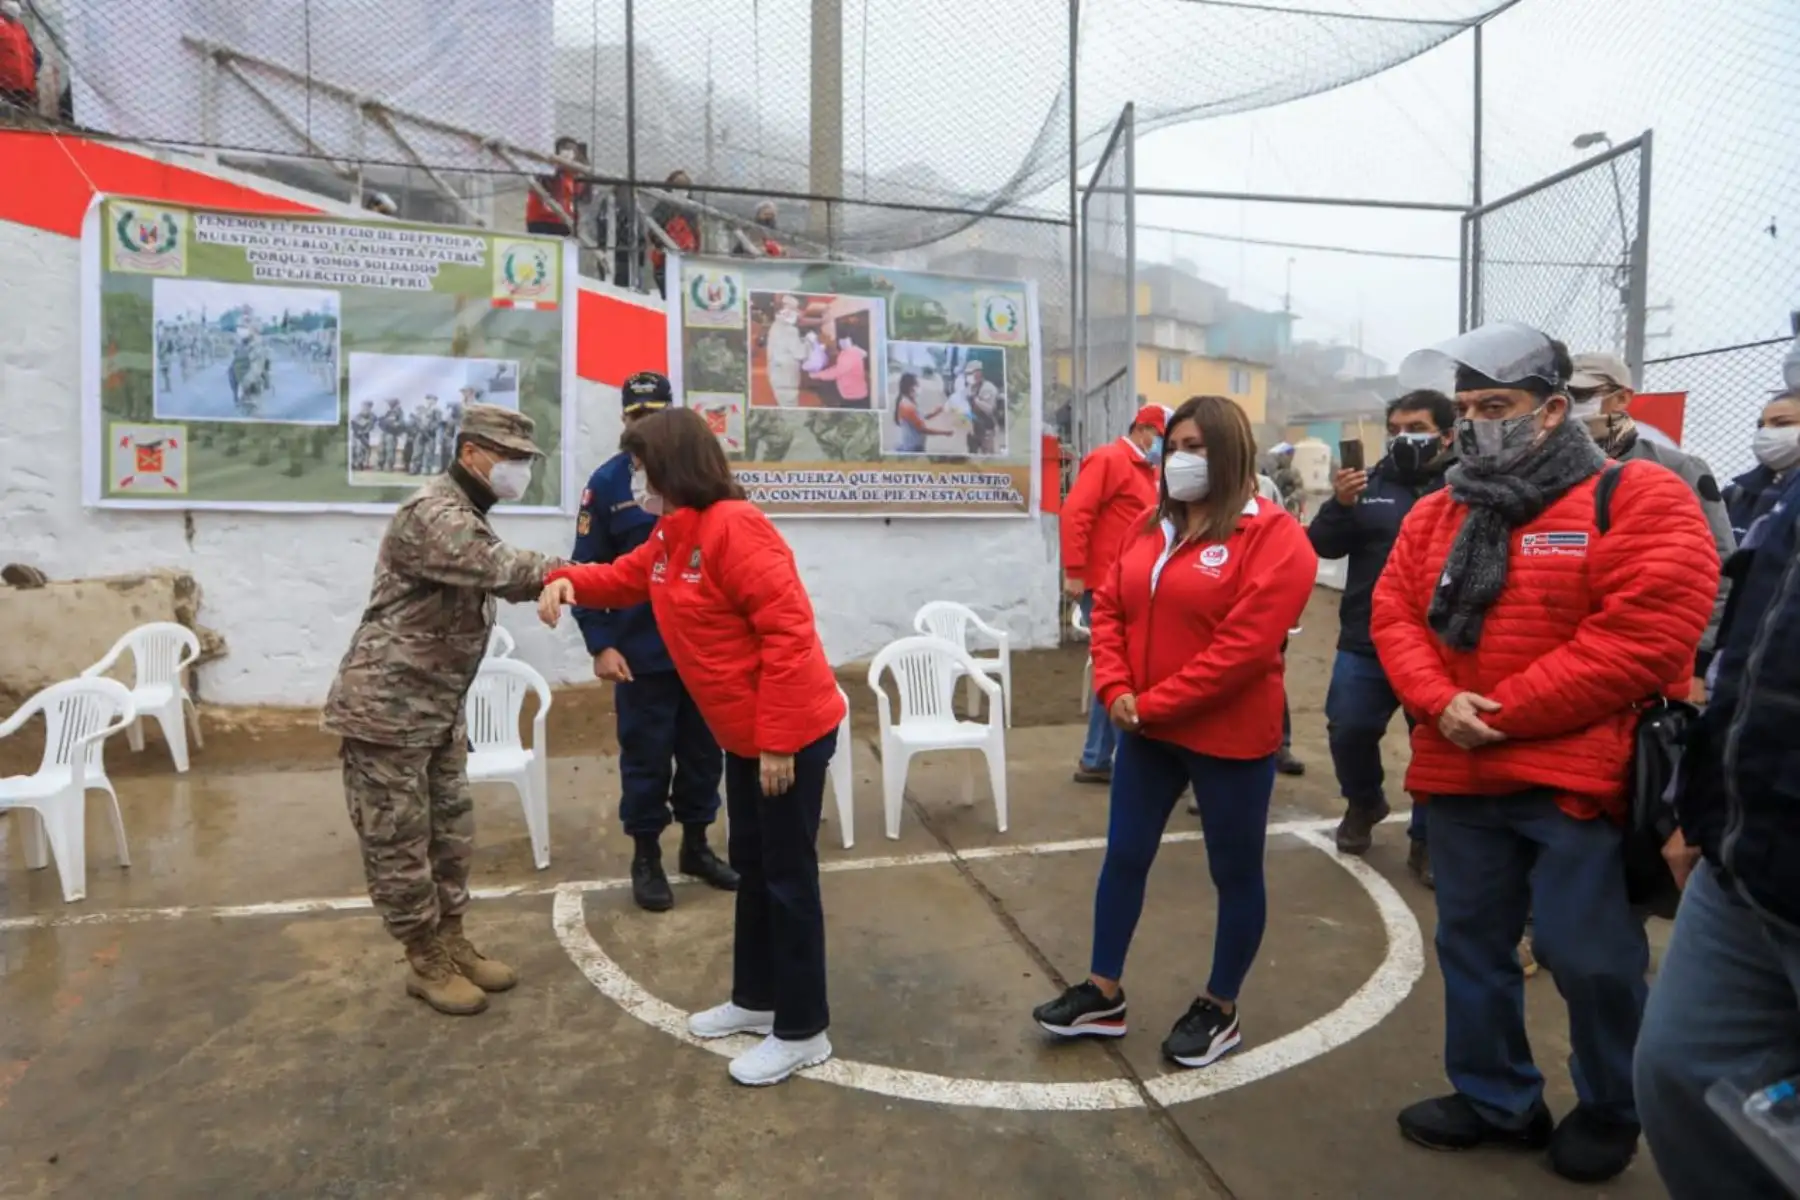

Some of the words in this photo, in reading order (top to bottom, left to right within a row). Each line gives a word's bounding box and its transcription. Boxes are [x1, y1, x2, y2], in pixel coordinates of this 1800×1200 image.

[197, 231, 269, 245] NUESTRO
[272, 237, 329, 250] PUEBLO
[346, 243, 356, 253] A
[360, 244, 426, 259] NUESTRA
[399, 232, 472, 247] DEFENDER
[248, 250, 308, 265] PORQUE
[312, 257, 360, 268] SOMOS
[364, 259, 438, 274] SOLDADOS
[360, 276, 387, 286] DEL
[764, 472, 783, 483] LA
[787, 472, 846, 484] FUERZA
[849, 473, 879, 486] QUE
[882, 473, 935, 485] MOTIVA
[938, 475, 949, 485] A
[951, 474, 1011, 486] NUESTRO
[756, 489, 767, 500] A
[771, 489, 858, 501] CONTINUAR
[862, 489, 881, 500] DE
[884, 490, 906, 501] PIE
[910, 490, 929, 500] EN
[932, 490, 965, 501] ESTA
